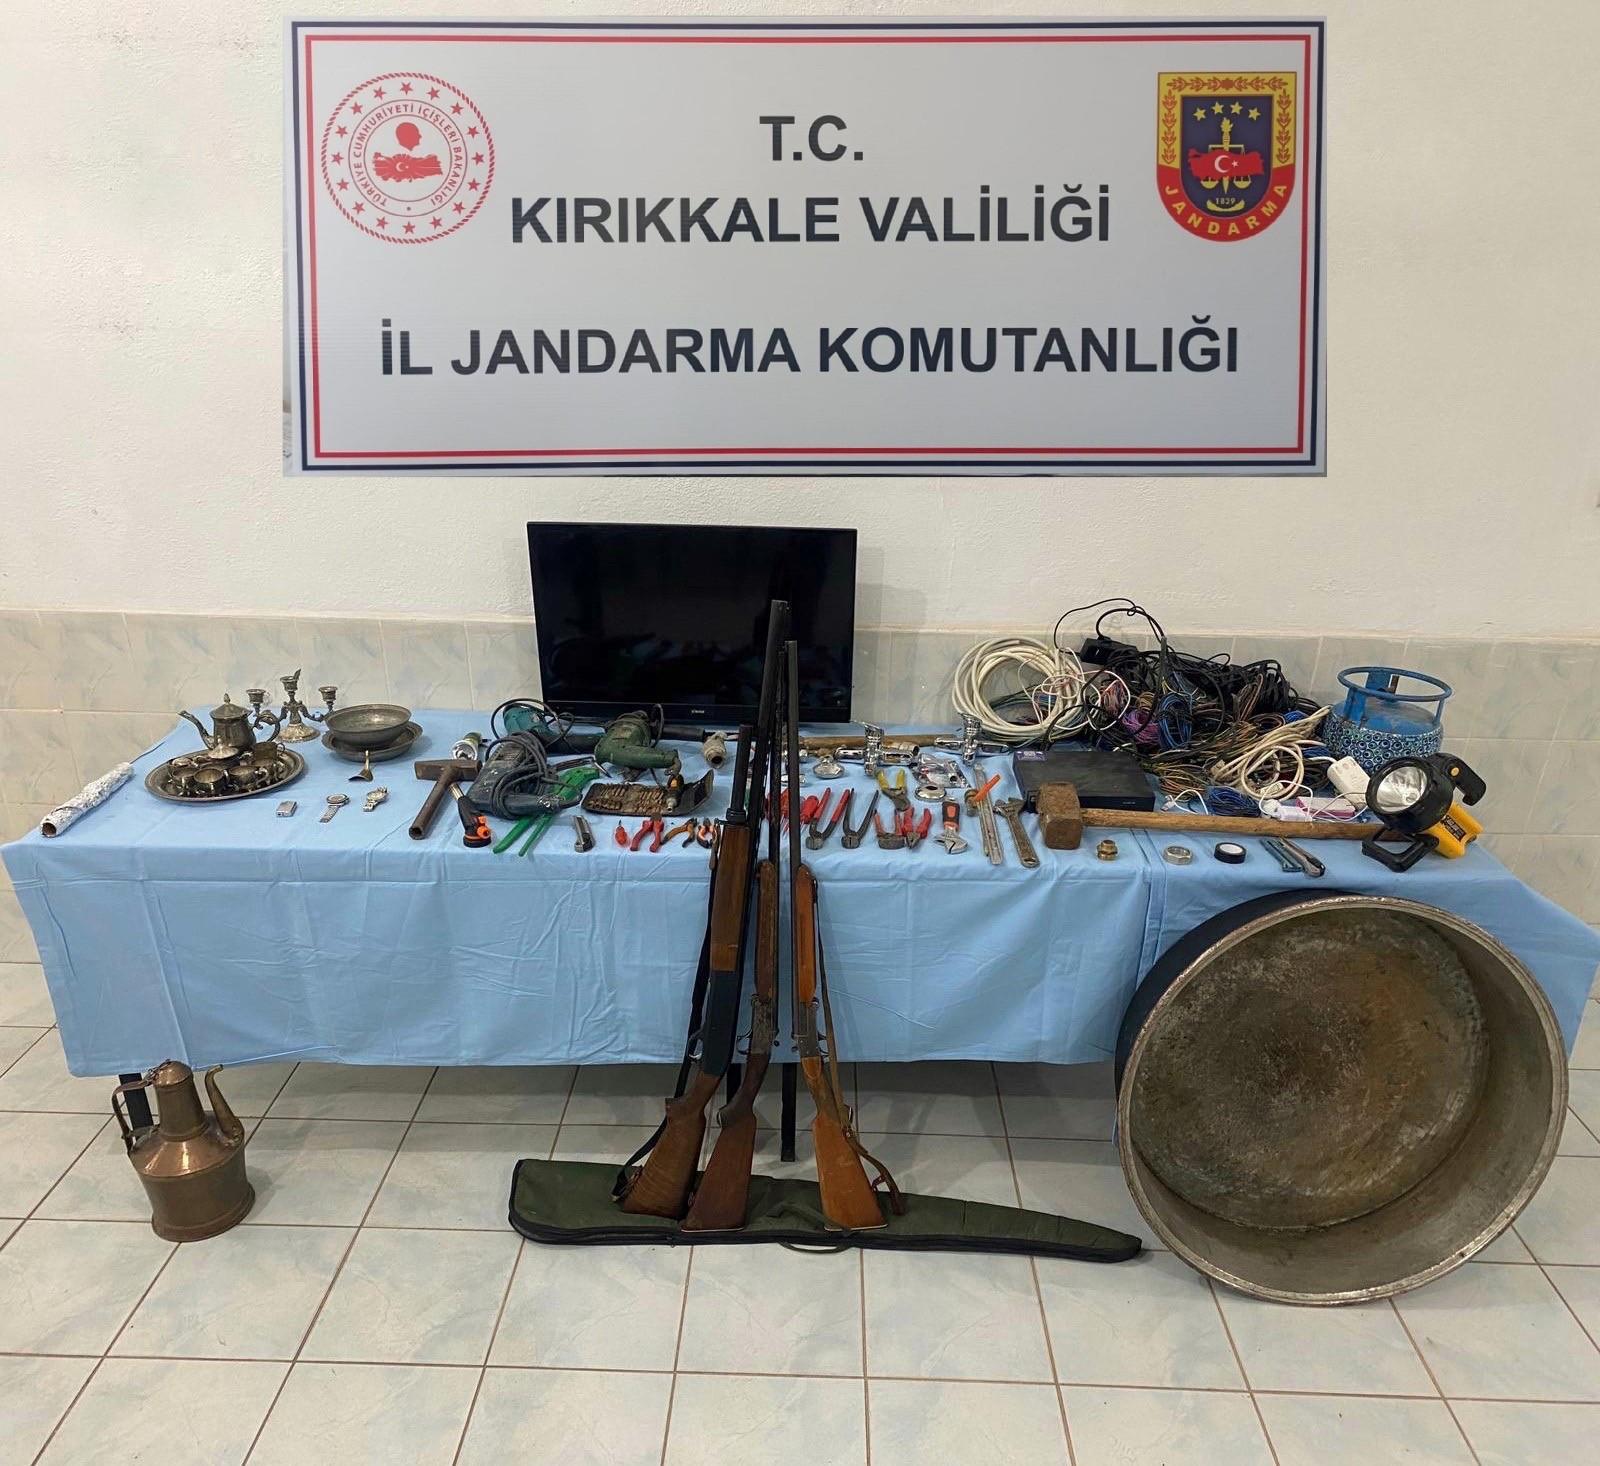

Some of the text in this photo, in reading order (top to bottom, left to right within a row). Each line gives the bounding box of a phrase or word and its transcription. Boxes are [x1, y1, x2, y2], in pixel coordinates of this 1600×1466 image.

[353, 103, 463, 206] TÜRKİYE CUMHURİYETİ İÇİŞLERİ BAKANLIĞI
[760, 115, 863, 161] T.C.
[512, 184, 1109, 243] KIRIKKALE VALİLİĞİ
[1165, 185, 1287, 236] JANDARMA
[382, 314, 1238, 376] İL JANDARMA KOMUTANLIĞI
